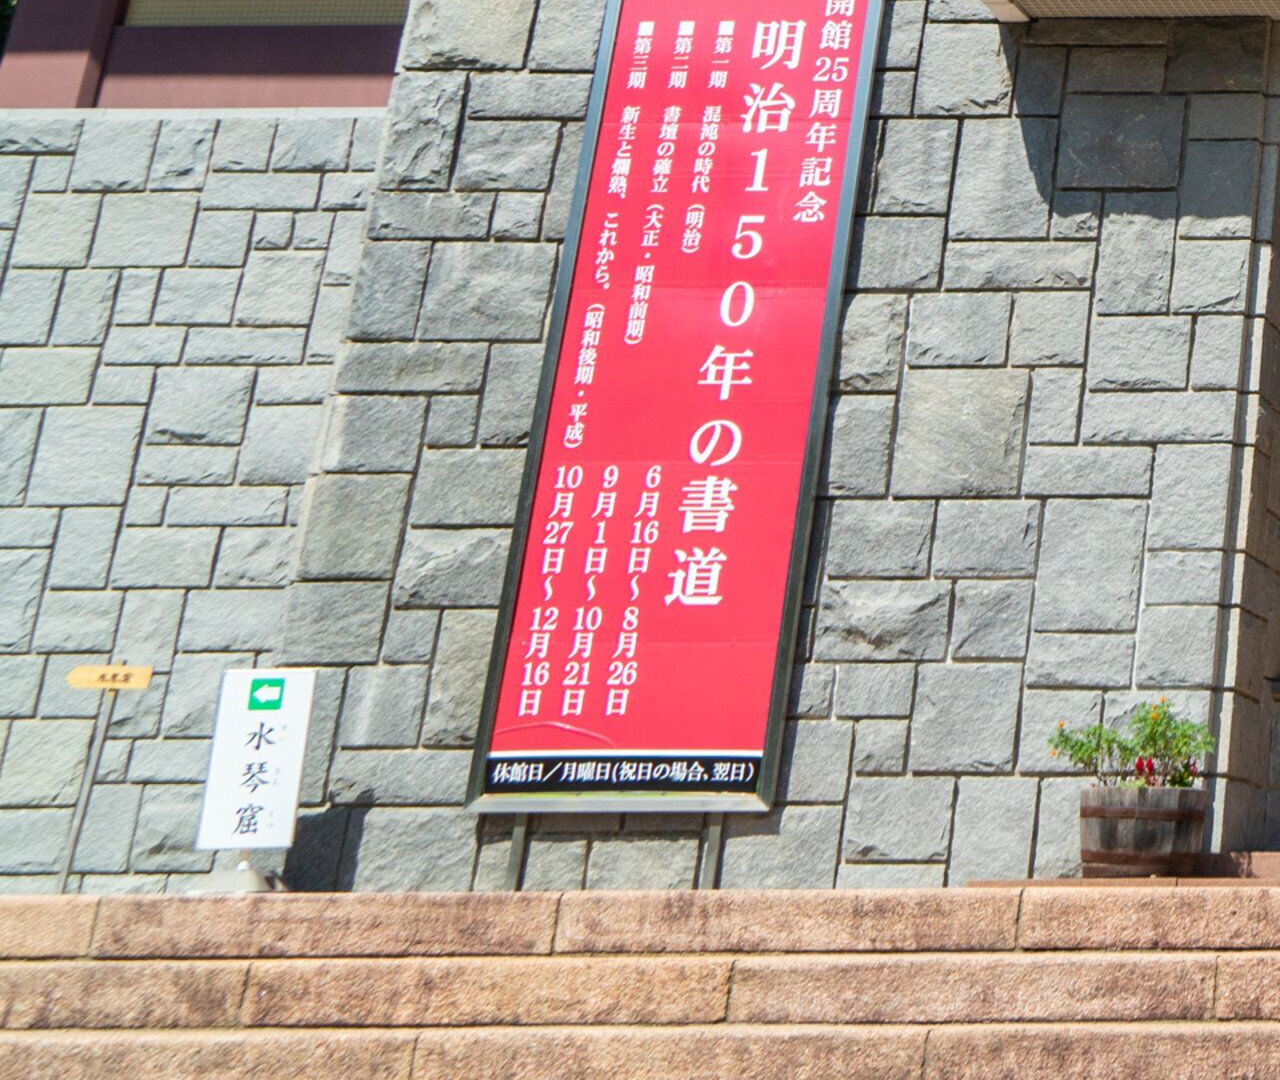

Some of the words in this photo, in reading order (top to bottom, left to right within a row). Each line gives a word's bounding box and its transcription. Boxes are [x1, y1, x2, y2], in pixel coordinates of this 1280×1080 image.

[663, 19, 807, 607] 明治150年の書道
[231, 722, 275, 835] 水琴窟
